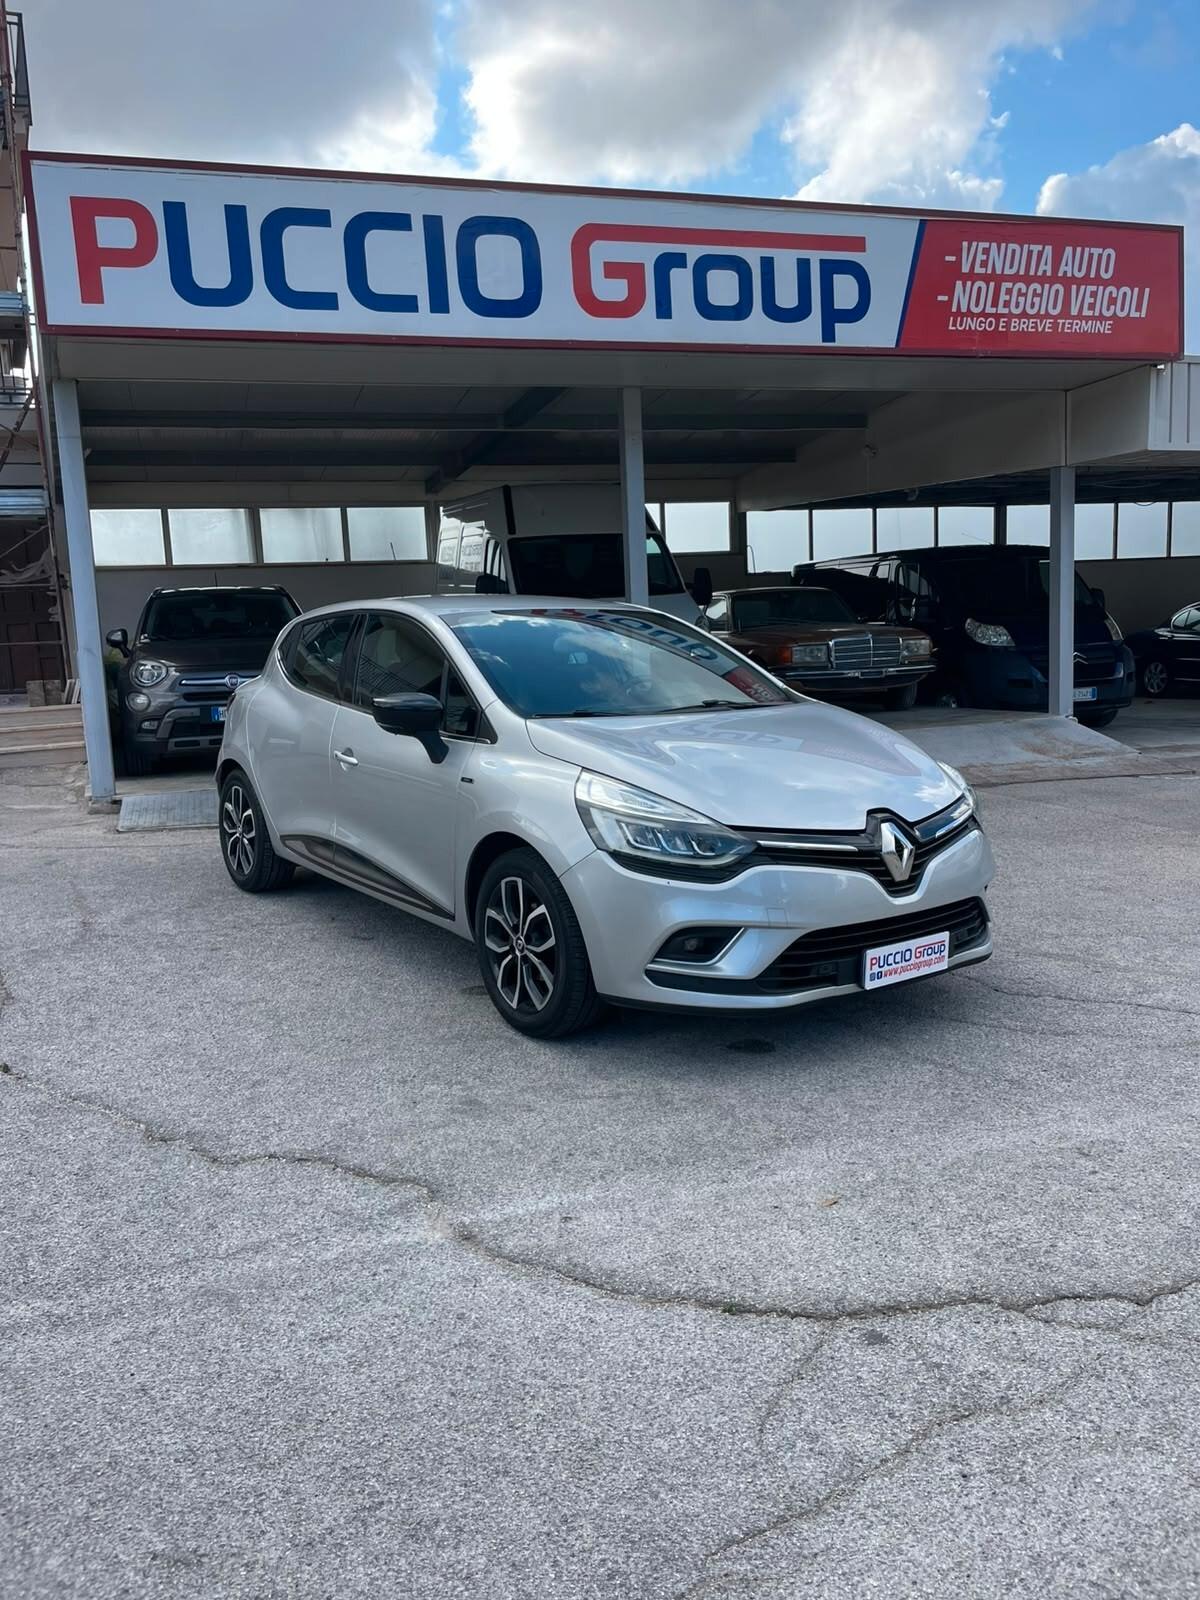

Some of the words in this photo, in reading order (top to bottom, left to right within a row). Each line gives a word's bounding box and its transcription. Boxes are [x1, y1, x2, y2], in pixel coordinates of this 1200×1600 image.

[69, 195, 544, 319] PUCCIO
[569, 222, 872, 343] Group
[1058, 246, 1117, 280] AUTO
[1070, 284, 1150, 318] VEICOLI
[948, 316, 996, 332] LUNGO
[998, 318, 1008, 332] E
[1010, 318, 1054, 333] BREVE
[1057, 319, 1114, 334] TERMINE
[870, 948, 912, 970] PUCCIO
[883, 955, 945, 977] www.pucciogroup.com
